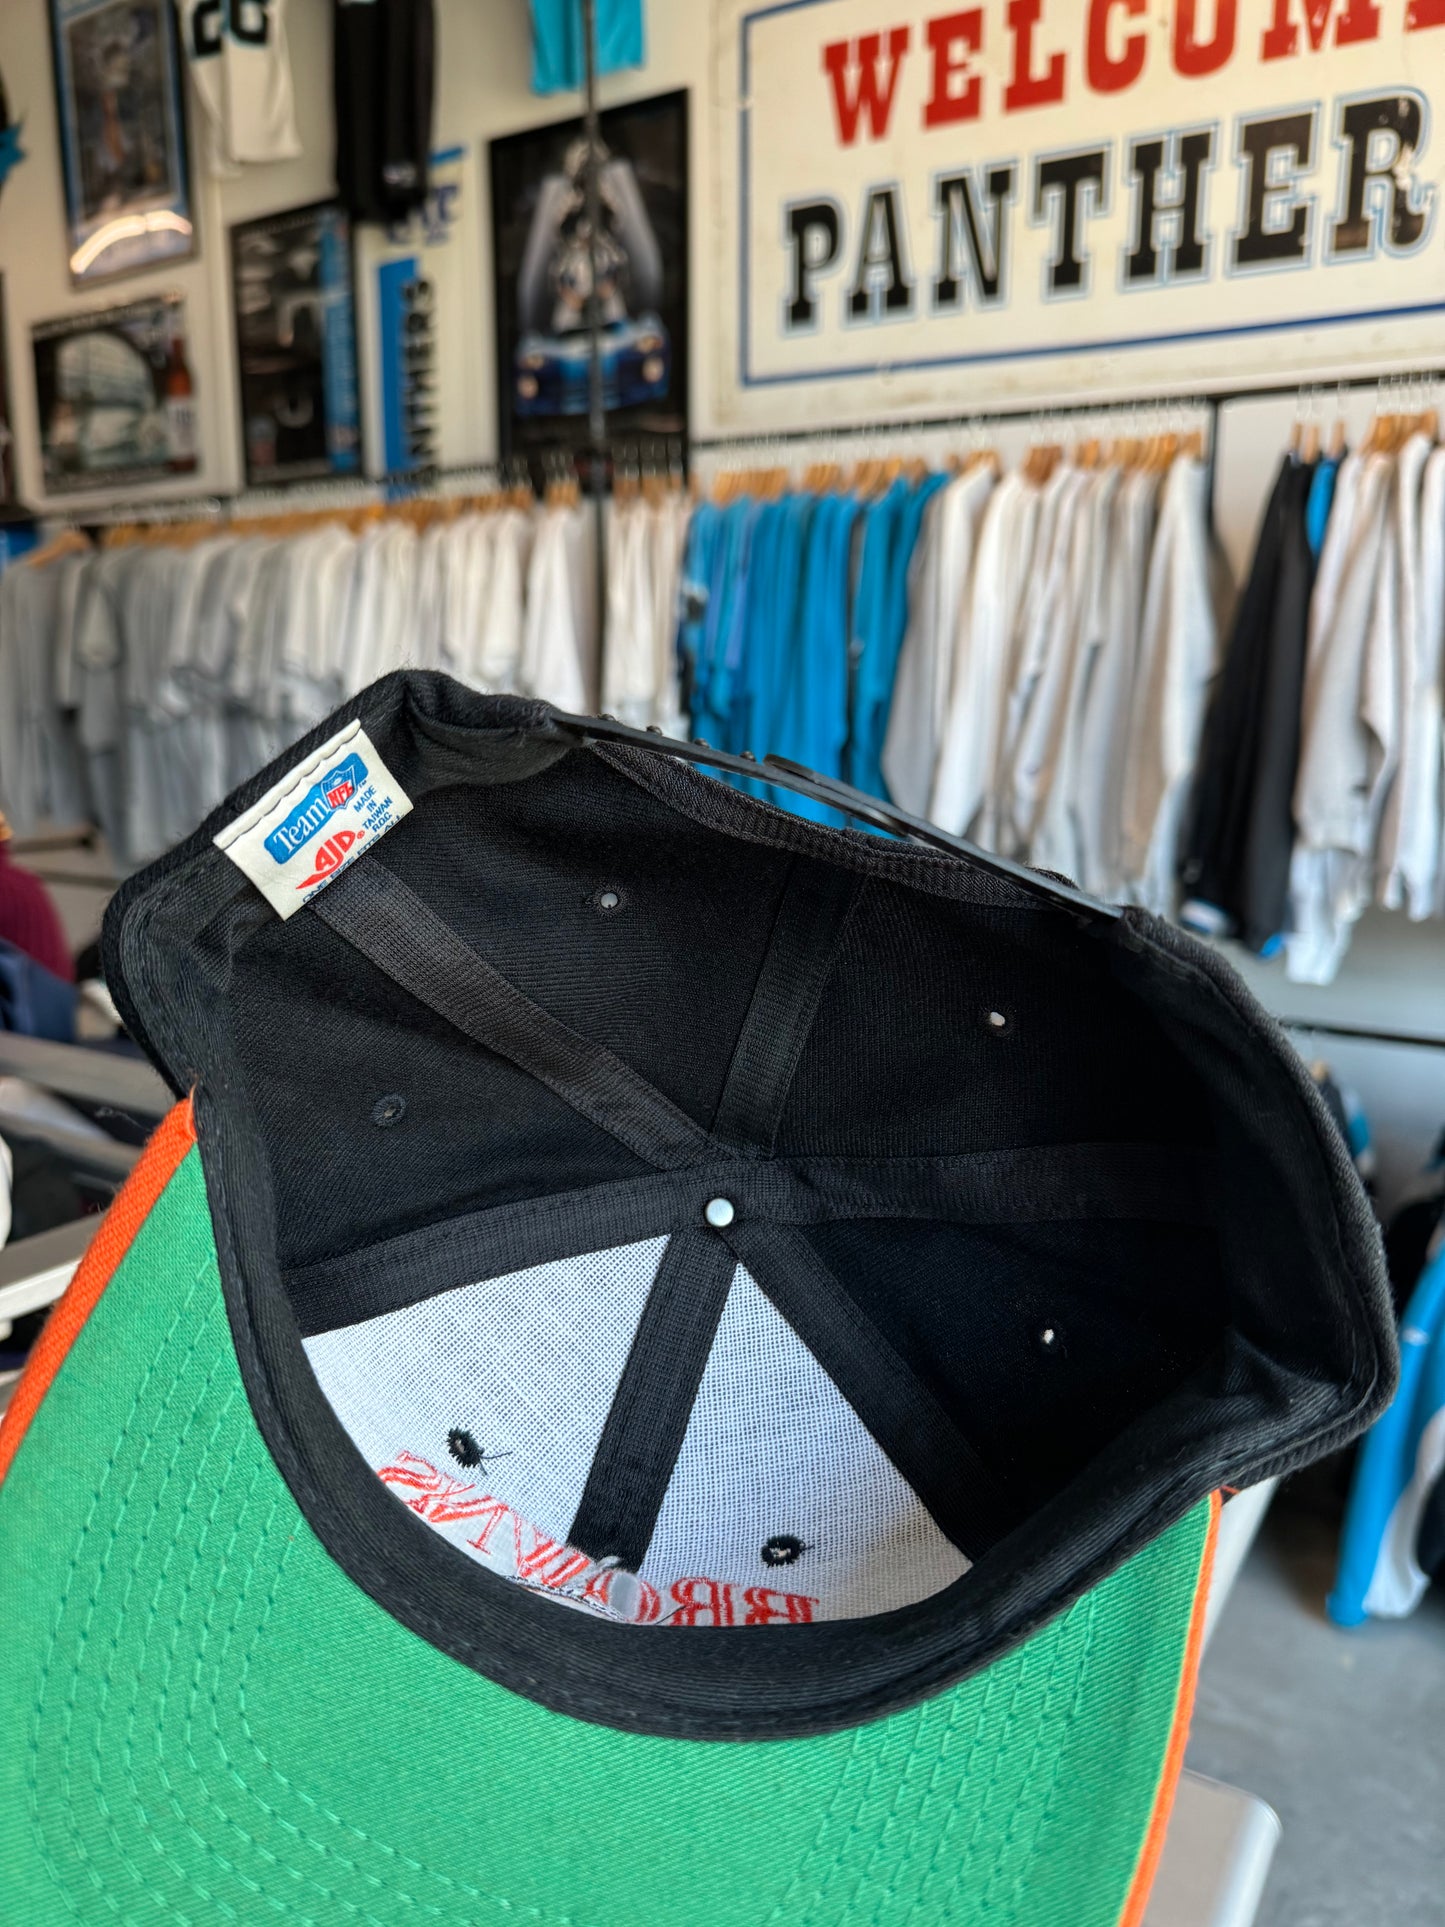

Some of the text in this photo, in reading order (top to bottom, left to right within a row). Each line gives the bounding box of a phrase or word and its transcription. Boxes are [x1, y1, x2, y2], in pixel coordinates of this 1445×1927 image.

[822, 0, 1445, 148] WELCO
[781, 85, 1438, 336] PANTHER
[273, 797, 331, 854] Team
[326, 779, 355, 808] NFL
[353, 785, 376, 812] MADE
[362, 796, 393, 830] TAIWAN
[366, 799, 377, 812] IN
[298, 830, 356, 887] AJD
